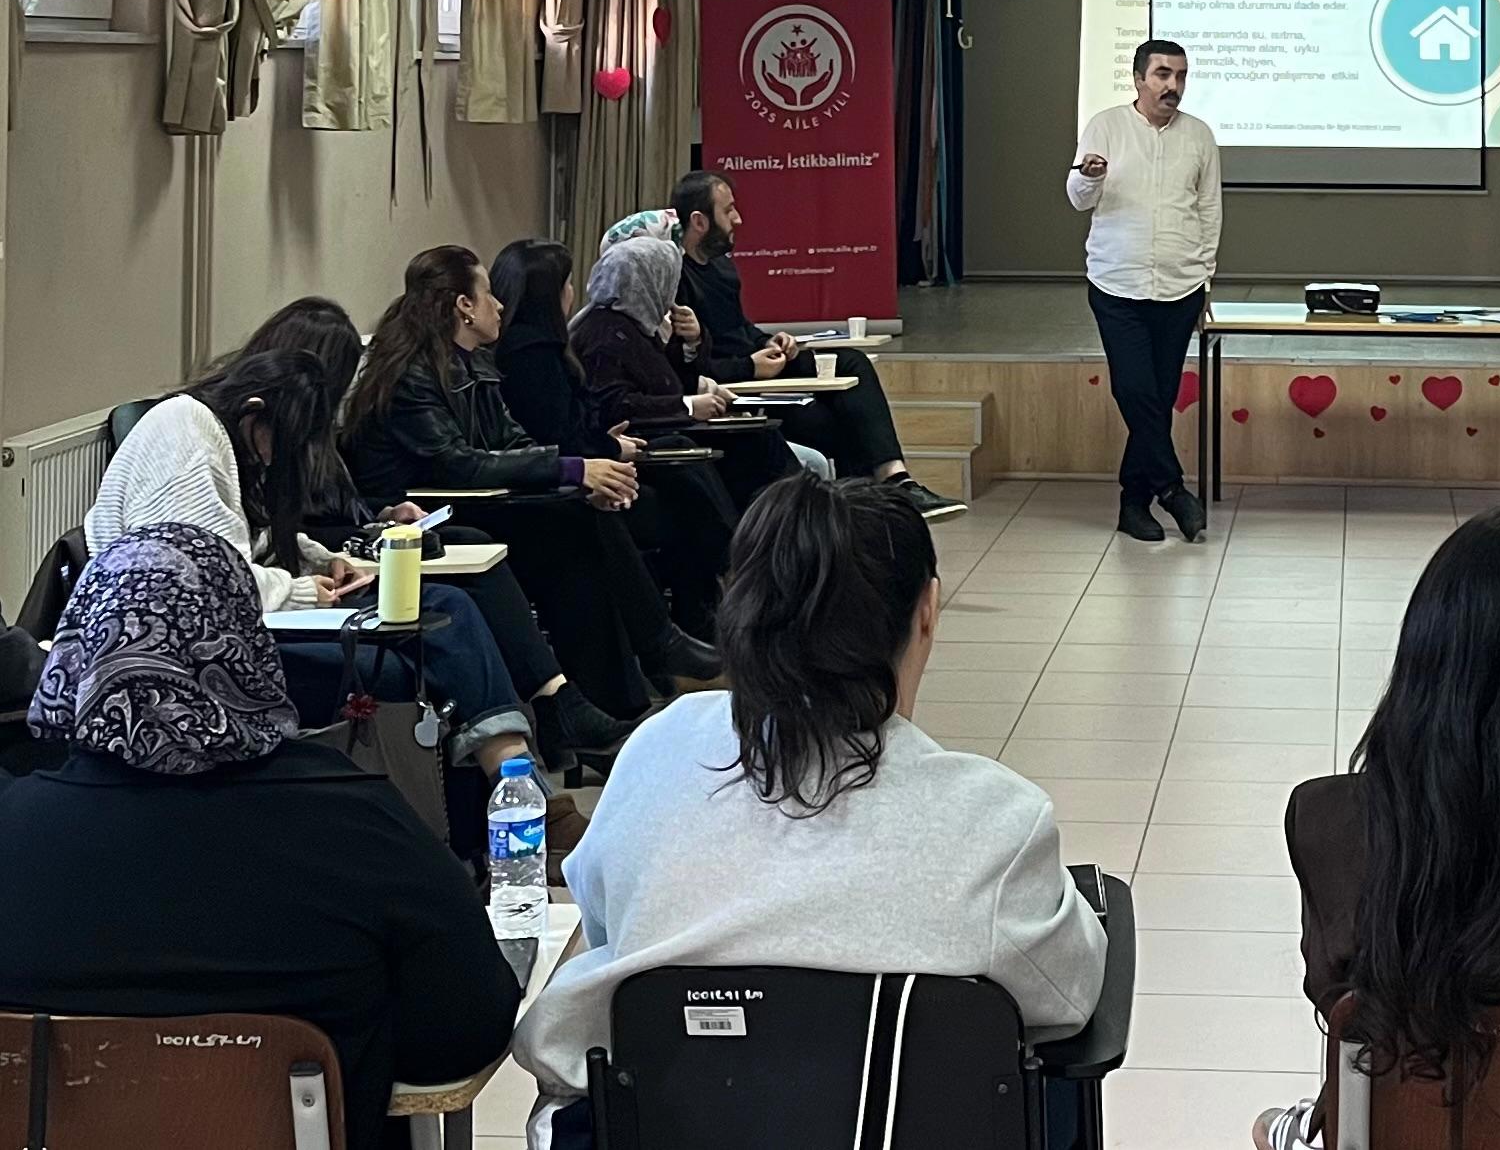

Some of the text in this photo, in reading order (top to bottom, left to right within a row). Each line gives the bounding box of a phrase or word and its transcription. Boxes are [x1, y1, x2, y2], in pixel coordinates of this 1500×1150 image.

[745, 91, 851, 130] 2025 AİLE YILI
